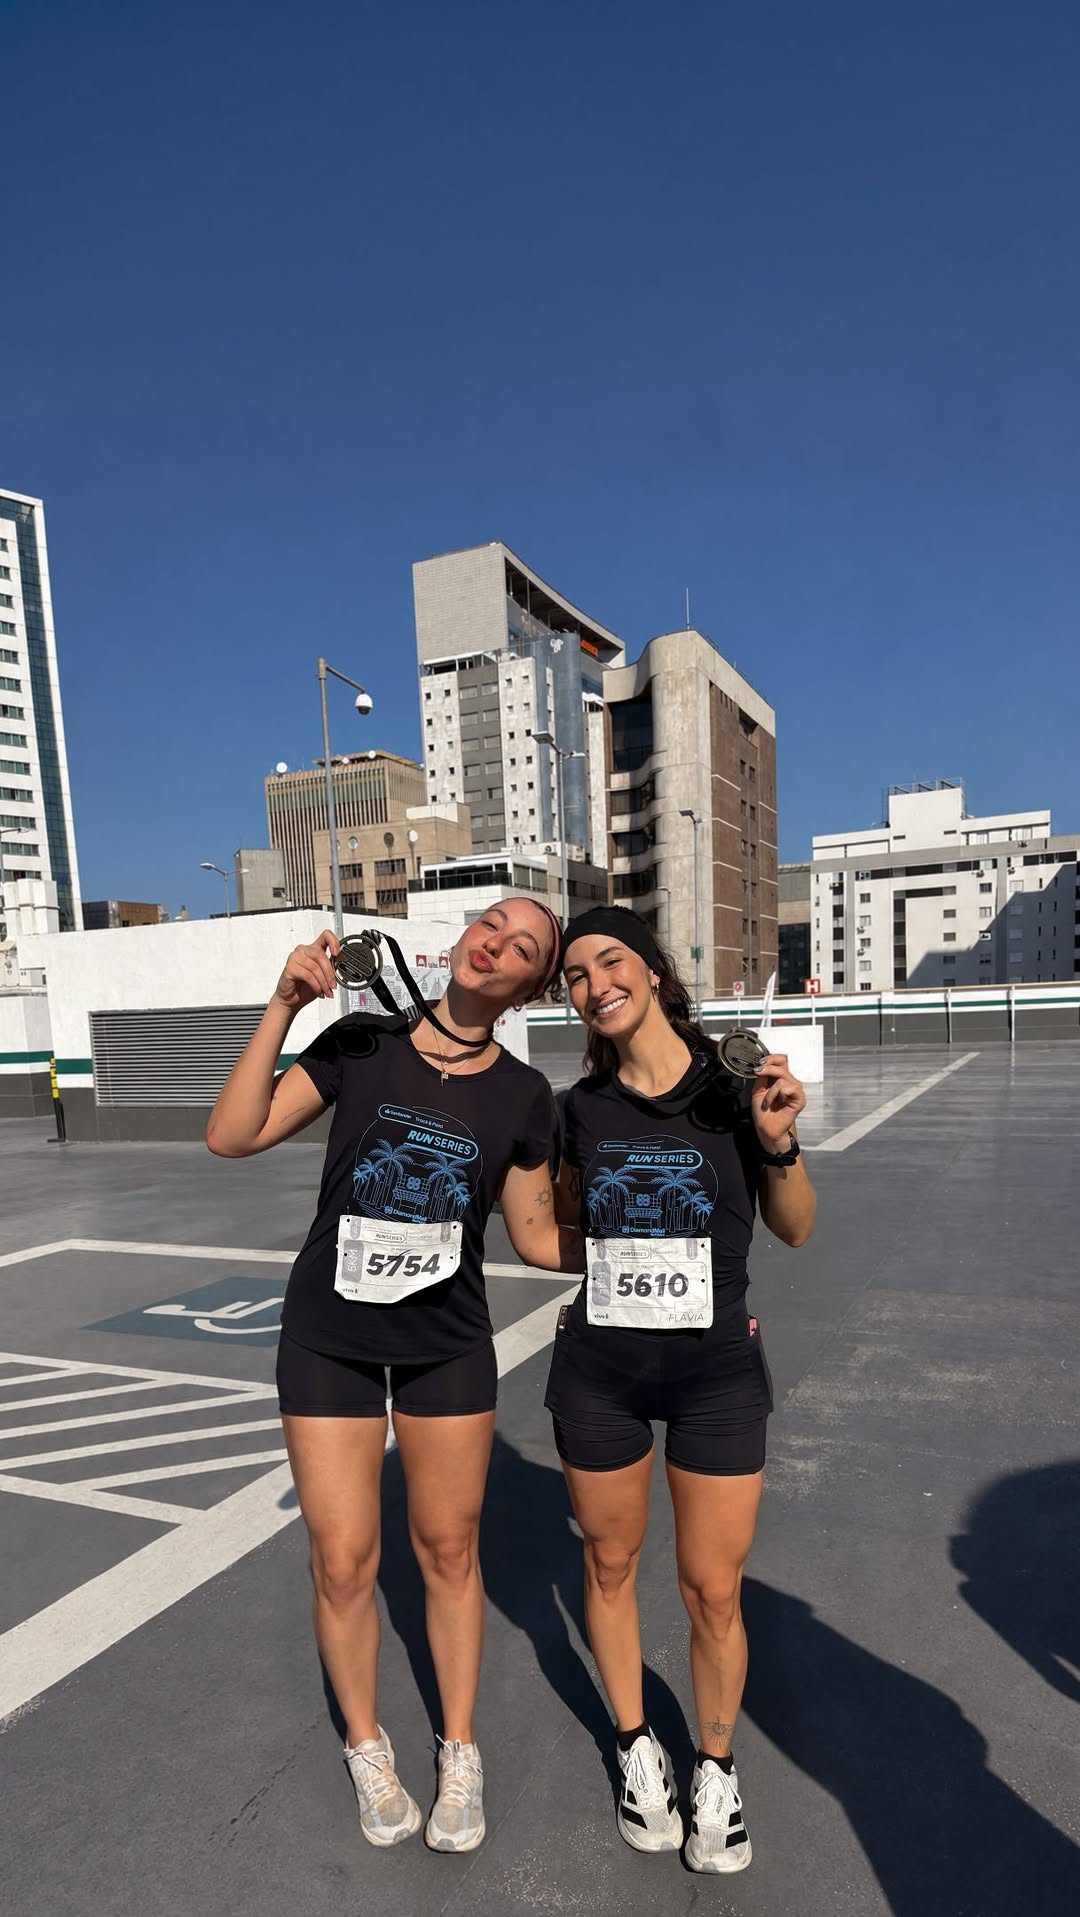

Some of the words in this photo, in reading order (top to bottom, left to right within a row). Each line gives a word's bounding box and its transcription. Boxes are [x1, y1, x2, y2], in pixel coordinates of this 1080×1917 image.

[807, 980, 818, 993] H
[347, 1248, 358, 1272] 5KM
[366, 1253, 440, 1277] 5754
[616, 1272, 689, 1298] 5610
